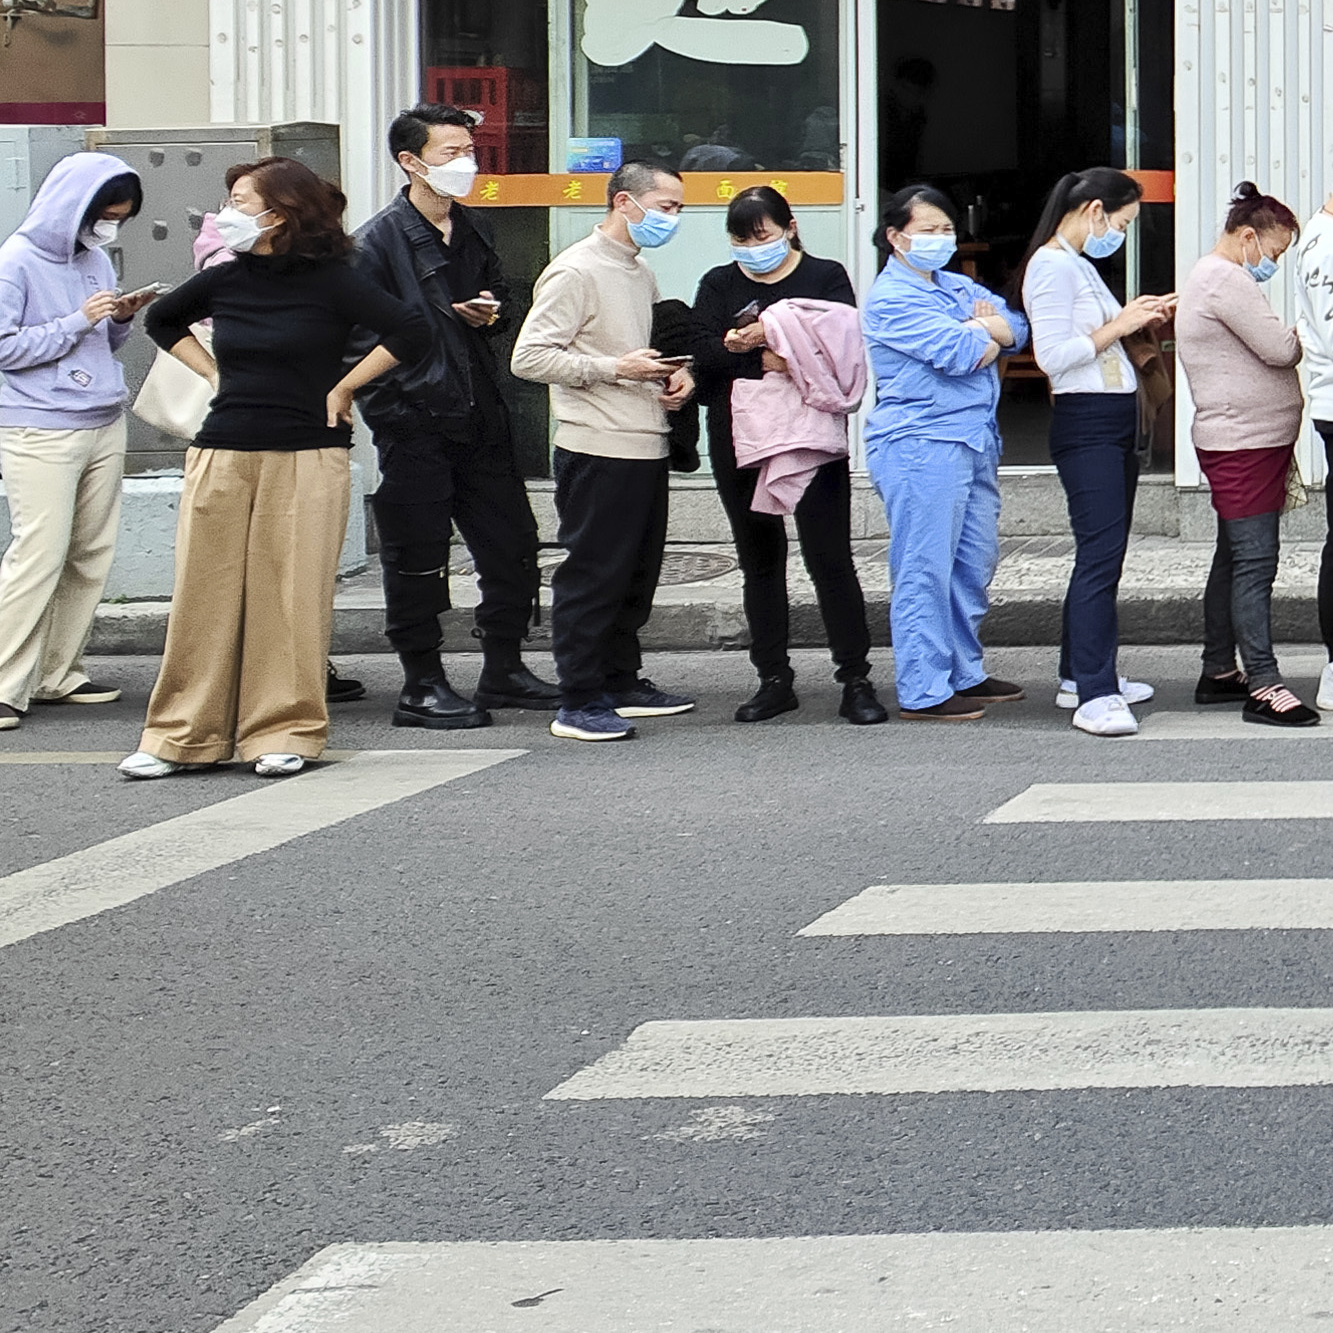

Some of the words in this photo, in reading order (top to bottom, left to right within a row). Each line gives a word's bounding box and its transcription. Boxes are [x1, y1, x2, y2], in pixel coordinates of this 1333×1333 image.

[479, 181, 499, 201] 老
[562, 179, 582, 199] 老
[716, 179, 734, 200] 面
